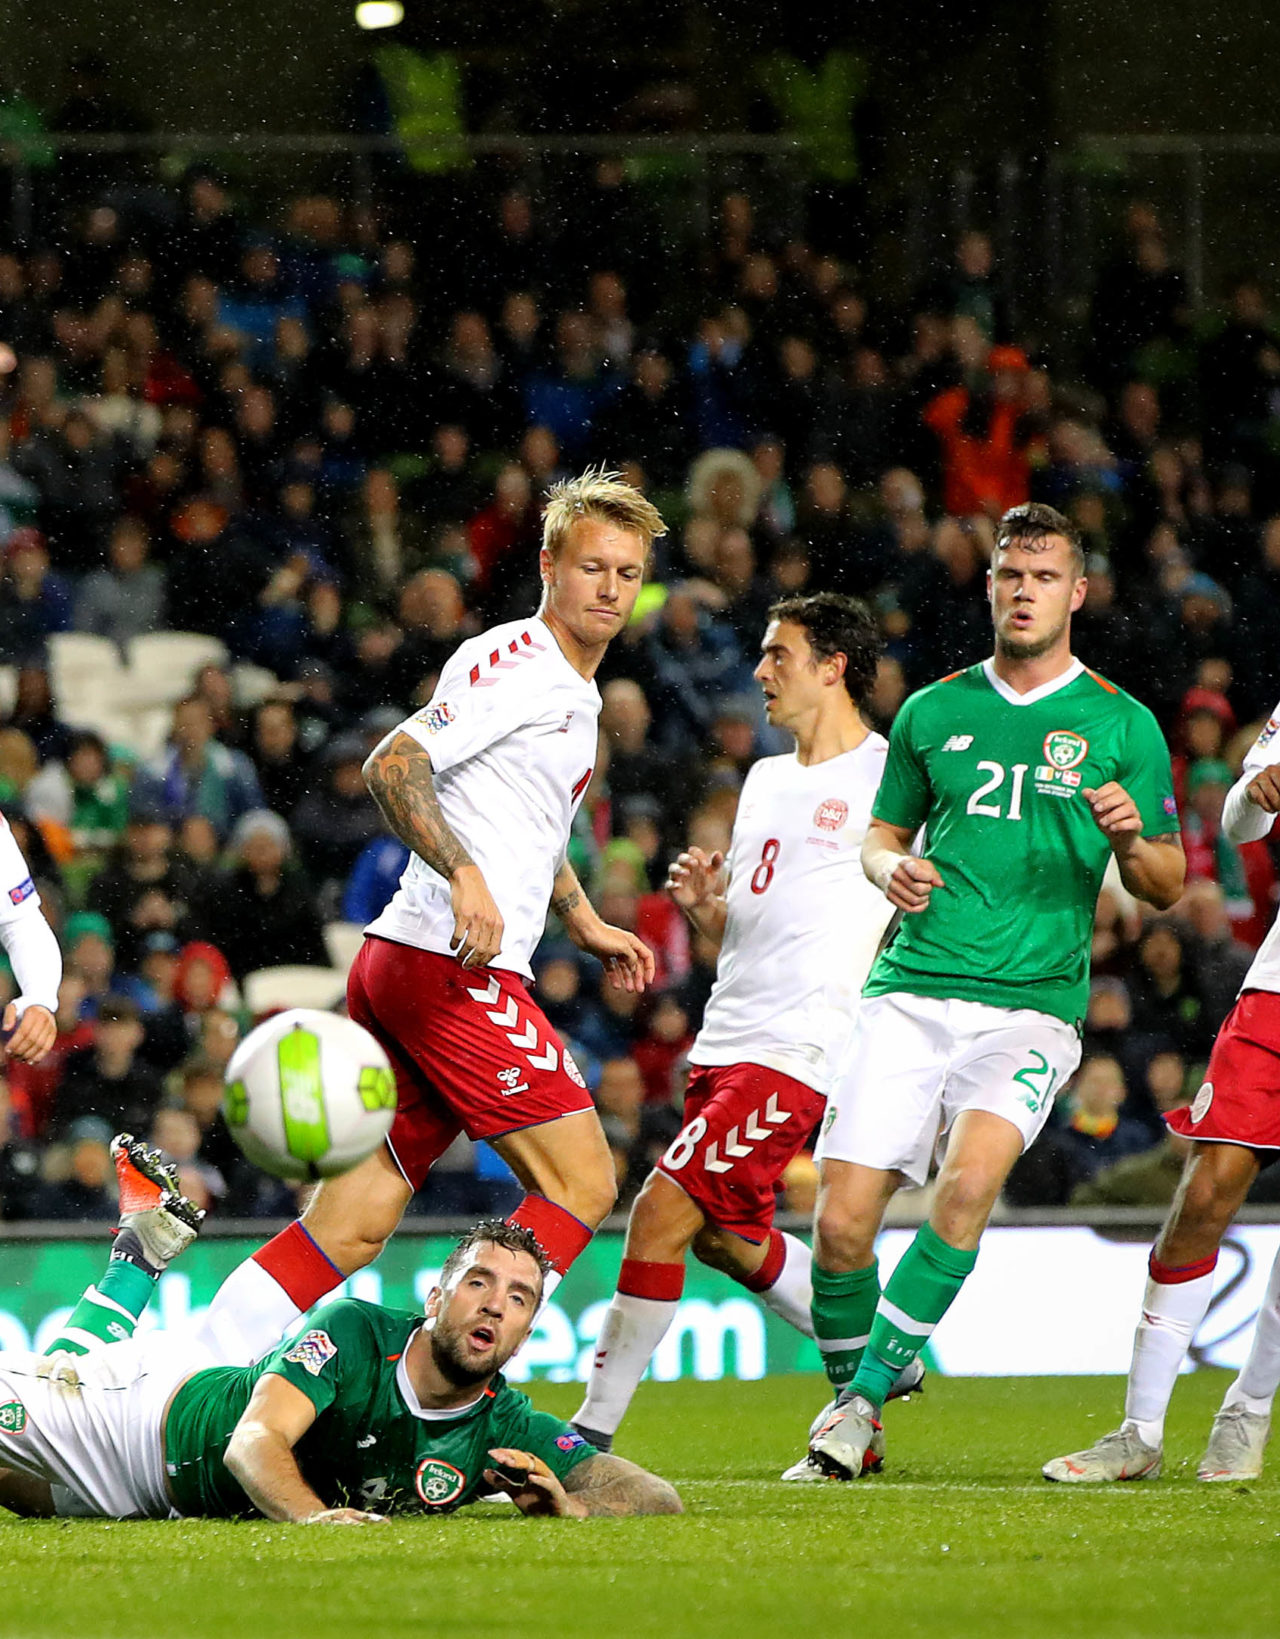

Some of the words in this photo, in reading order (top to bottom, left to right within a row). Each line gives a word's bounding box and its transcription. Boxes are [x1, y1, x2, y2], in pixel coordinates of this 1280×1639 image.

[966, 759, 1030, 820] 21
[751, 837, 781, 895] 8
[1012, 1048, 1058, 1112] 21
[662, 1116, 708, 1171] 8
[428, 1464, 459, 1483] Ireland
